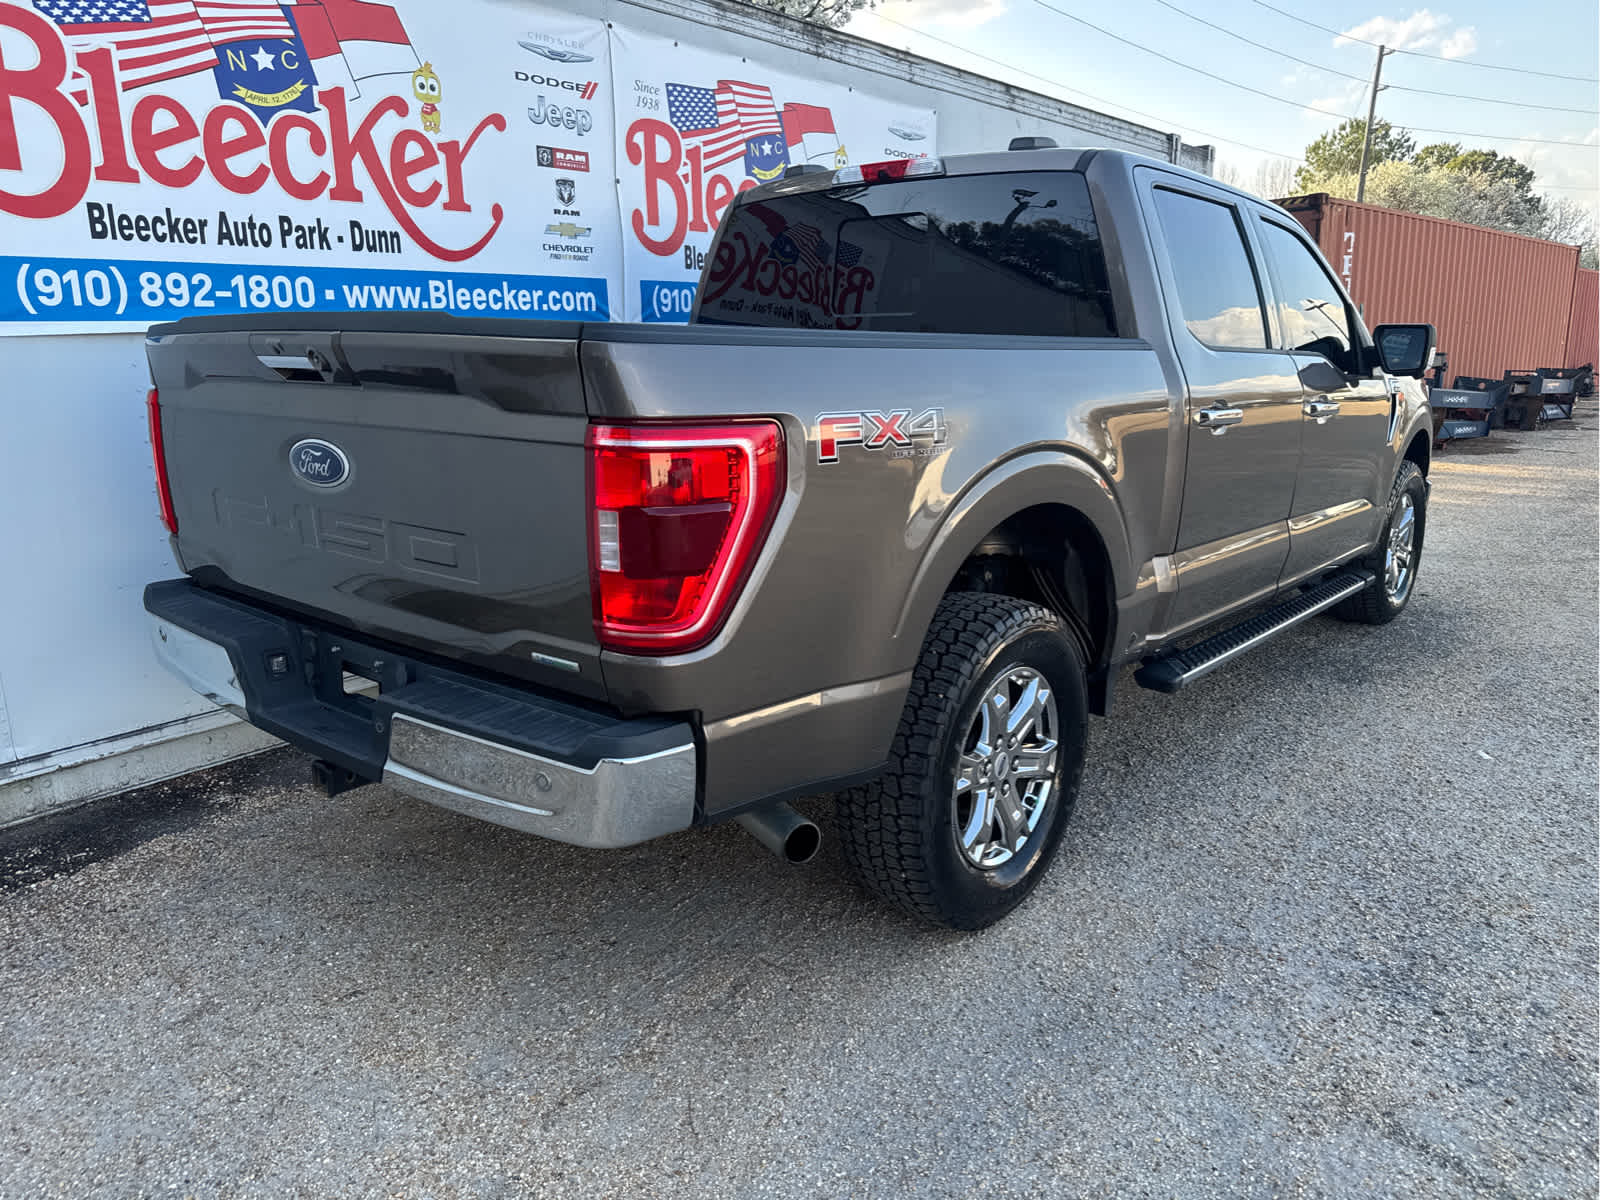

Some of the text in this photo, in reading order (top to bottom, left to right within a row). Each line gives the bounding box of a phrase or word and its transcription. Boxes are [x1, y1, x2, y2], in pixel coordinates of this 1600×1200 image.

[226, 49, 299, 71] N C
[514, 71, 588, 94] DODGE
[633, 80, 661, 95] Since
[528, 95, 593, 136] Jeep
[636, 96, 660, 111] 1938
[0, 2, 507, 262] Bleecker
[556, 152, 586, 162] RAM
[626, 118, 760, 256] Ble
[553, 208, 581, 216] RAM
[86, 201, 208, 245] Bleecker
[217, 210, 273, 248] Auto
[278, 215, 332, 251] Park
[349, 219, 402, 254] Dunn
[542, 243, 595, 254] CHEVROLET
[684, 244, 709, 270] Ble
[16, 264, 597, 315] (910) 892-1800 www.Bleecker.com
[815, 407, 948, 466] FX4
[300, 448, 331, 476] Ford
